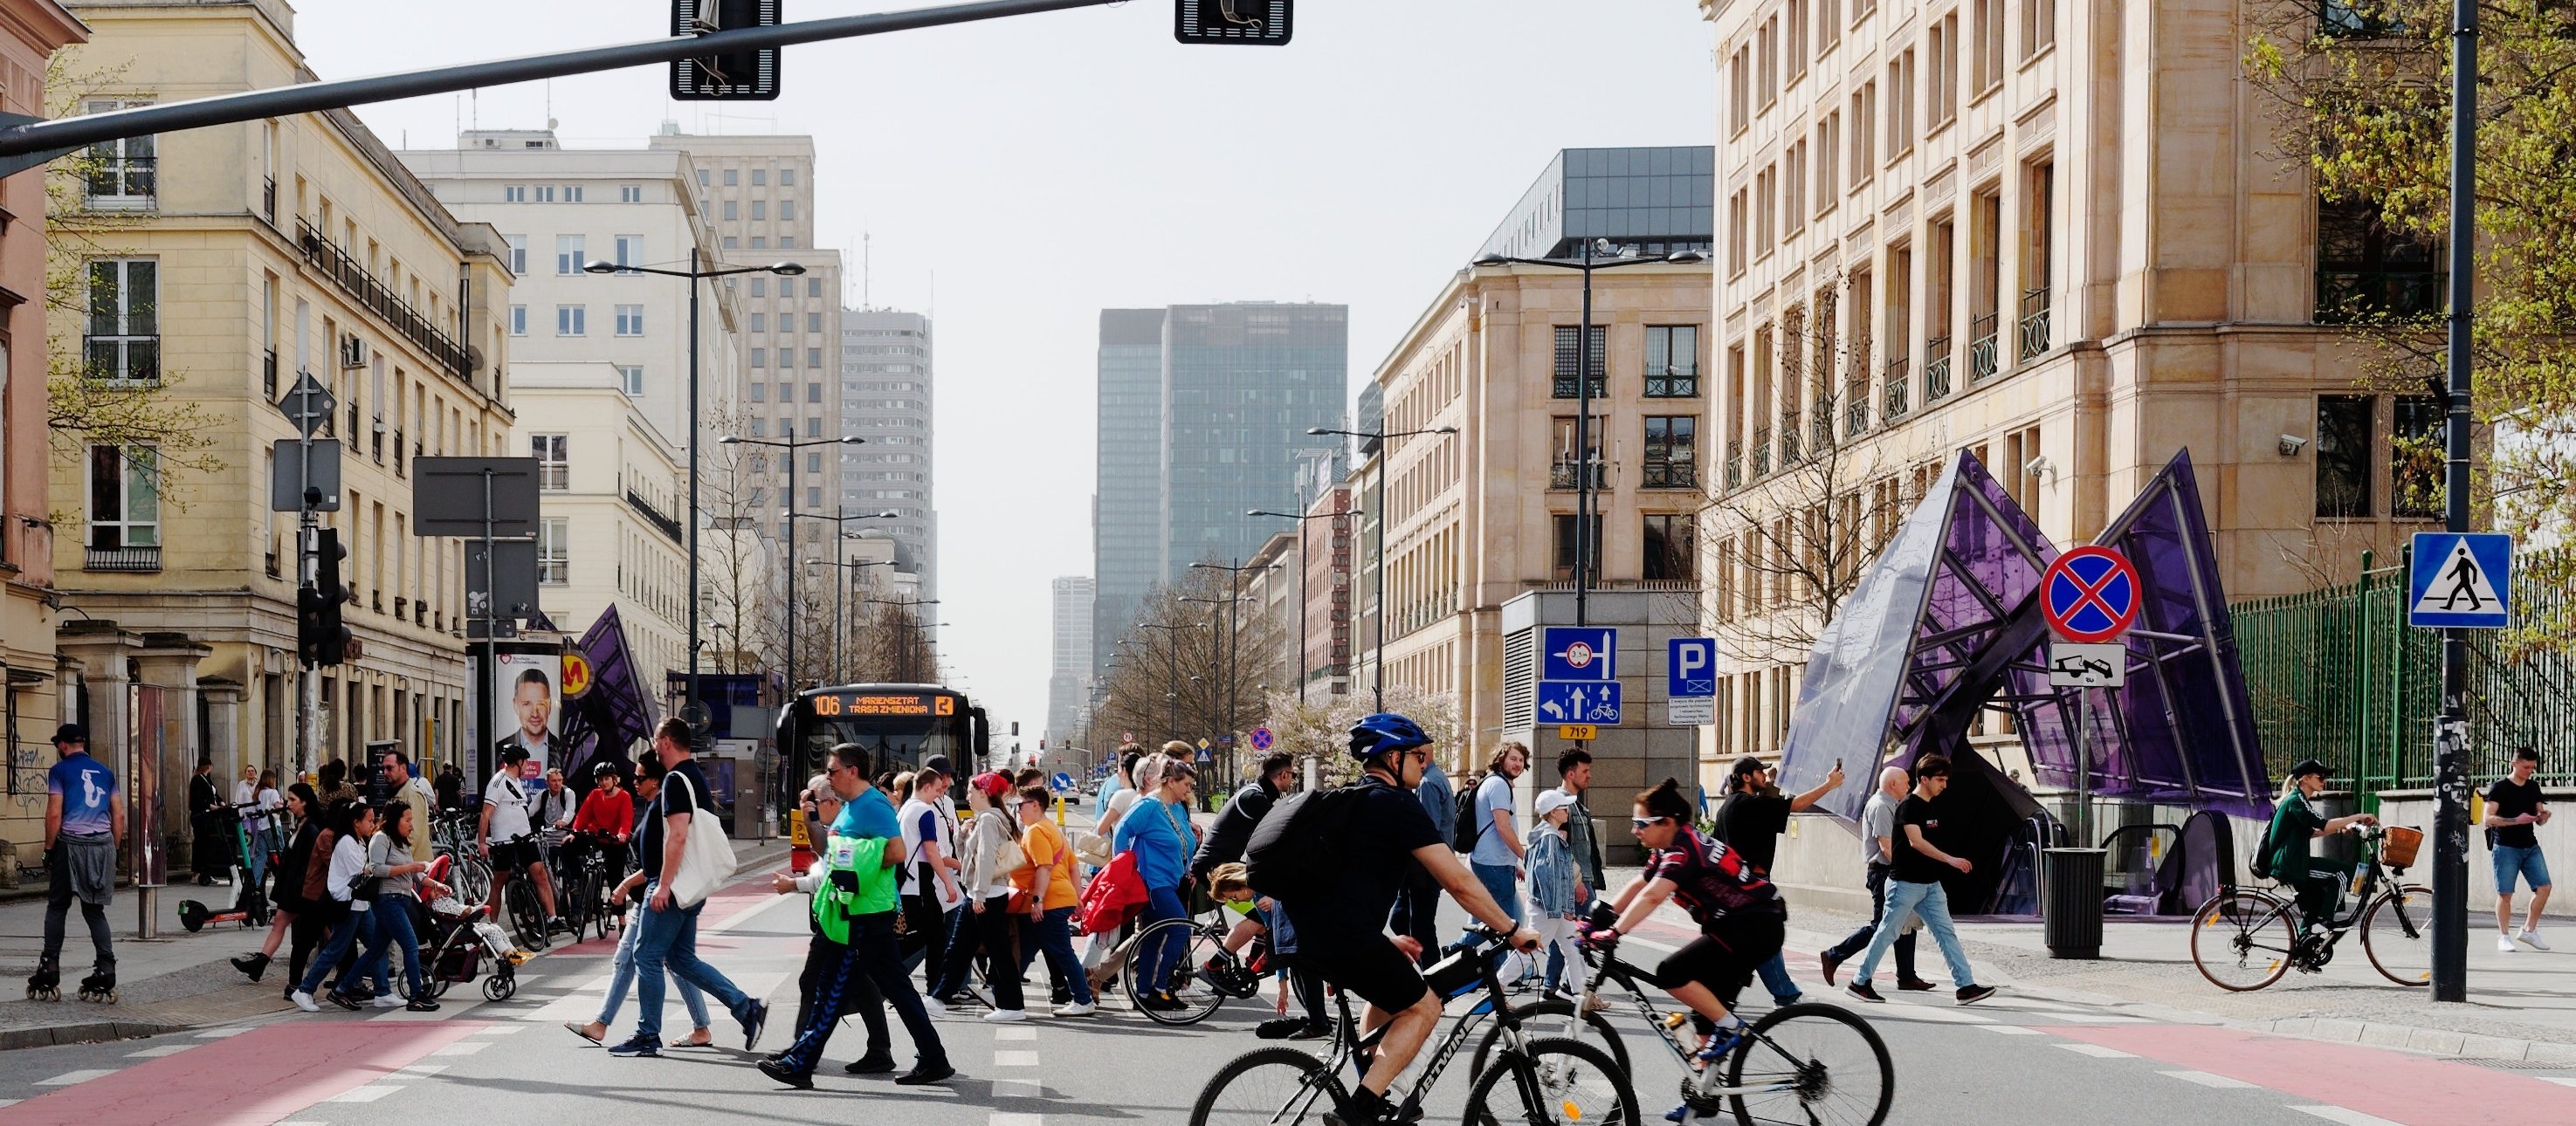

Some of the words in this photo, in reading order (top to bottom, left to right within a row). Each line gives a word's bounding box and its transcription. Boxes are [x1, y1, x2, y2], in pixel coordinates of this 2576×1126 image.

[1679, 643, 1706, 679] P
[814, 695, 840, 716] 106
[849, 705, 878, 714] TRASA
[879, 705, 928, 714] ZMIENIONA
[1569, 726, 1588, 738] 719
